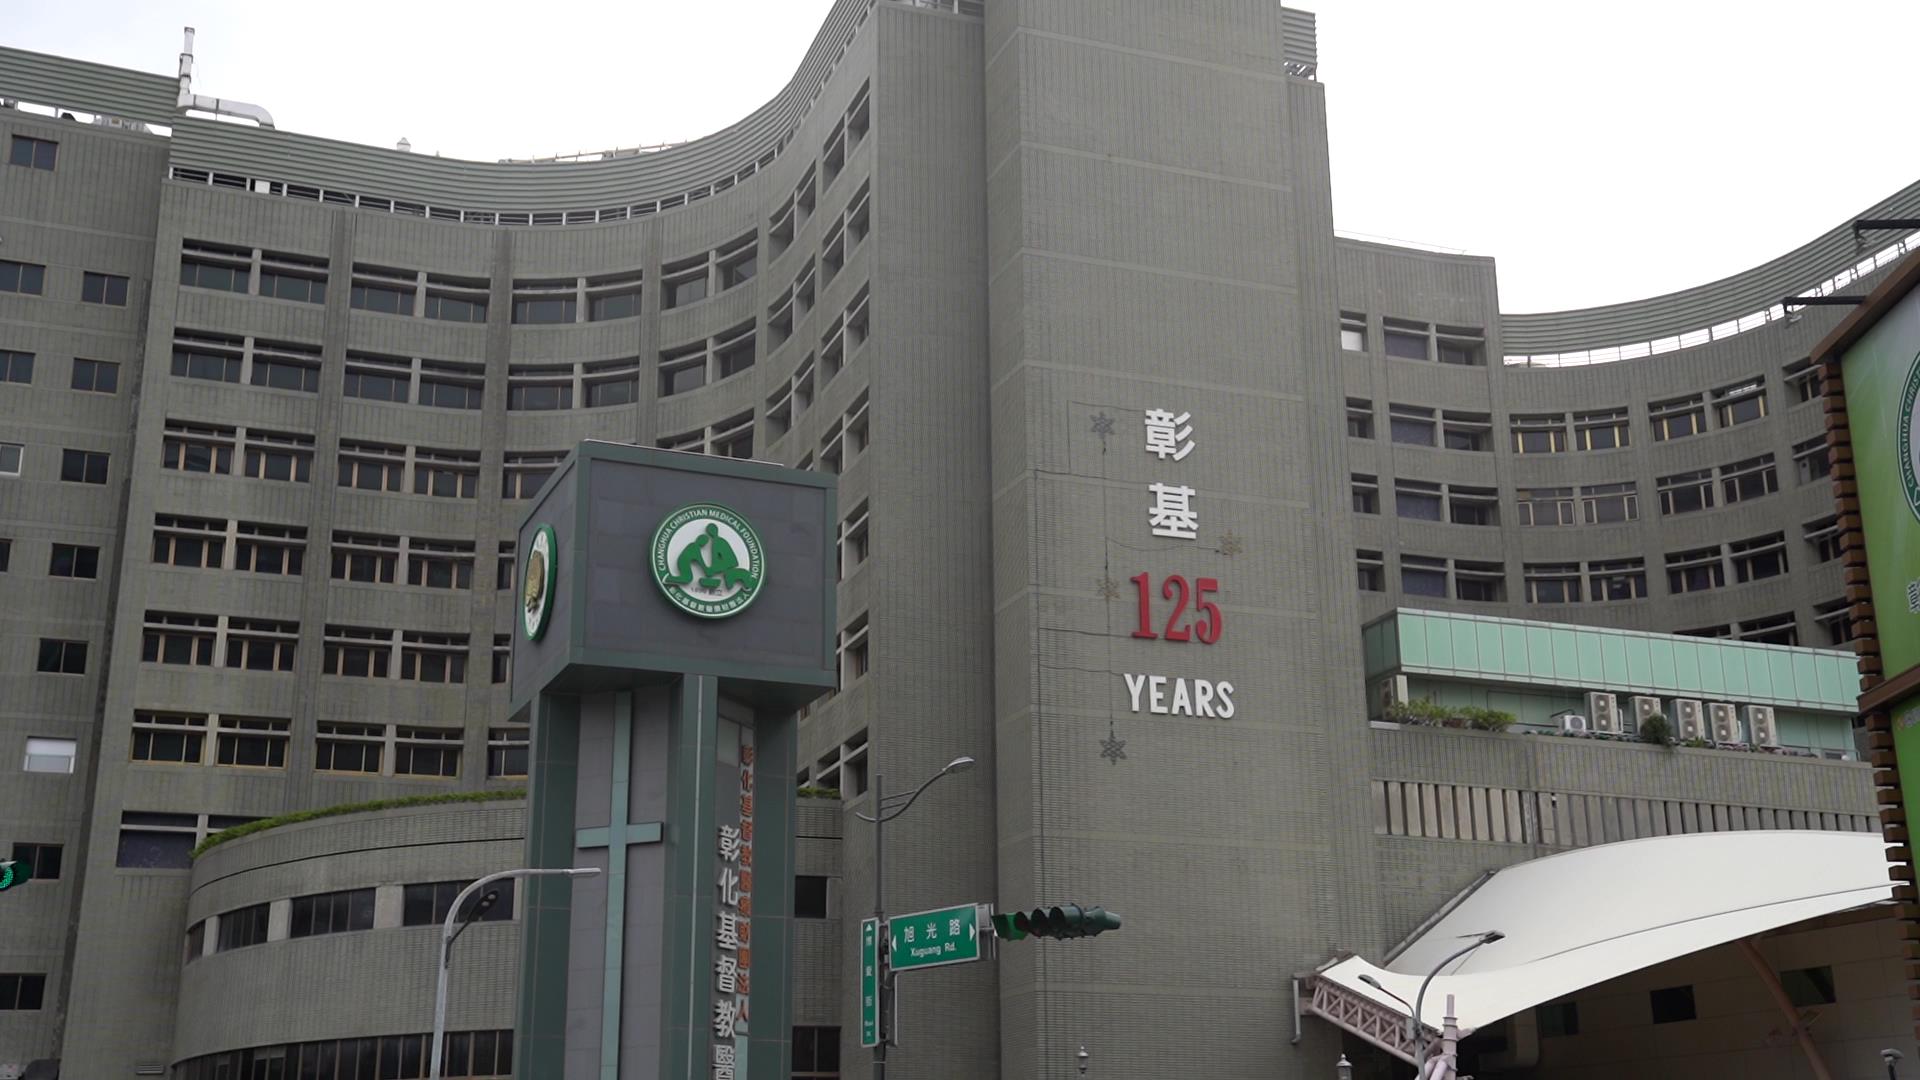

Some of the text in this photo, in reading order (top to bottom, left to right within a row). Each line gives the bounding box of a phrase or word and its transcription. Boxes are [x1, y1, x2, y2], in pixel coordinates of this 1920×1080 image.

[1145, 408, 1199, 540] 彰基
[656, 509, 761, 579] CHANGHUA CHRISTIAN MEDICAL FOUNDATION
[1130, 571, 1223, 645] 125
[1123, 672, 1235, 720] YEARS
[904, 918, 961, 943] 旭光路
[911, 945, 941, 958] Xuguang
